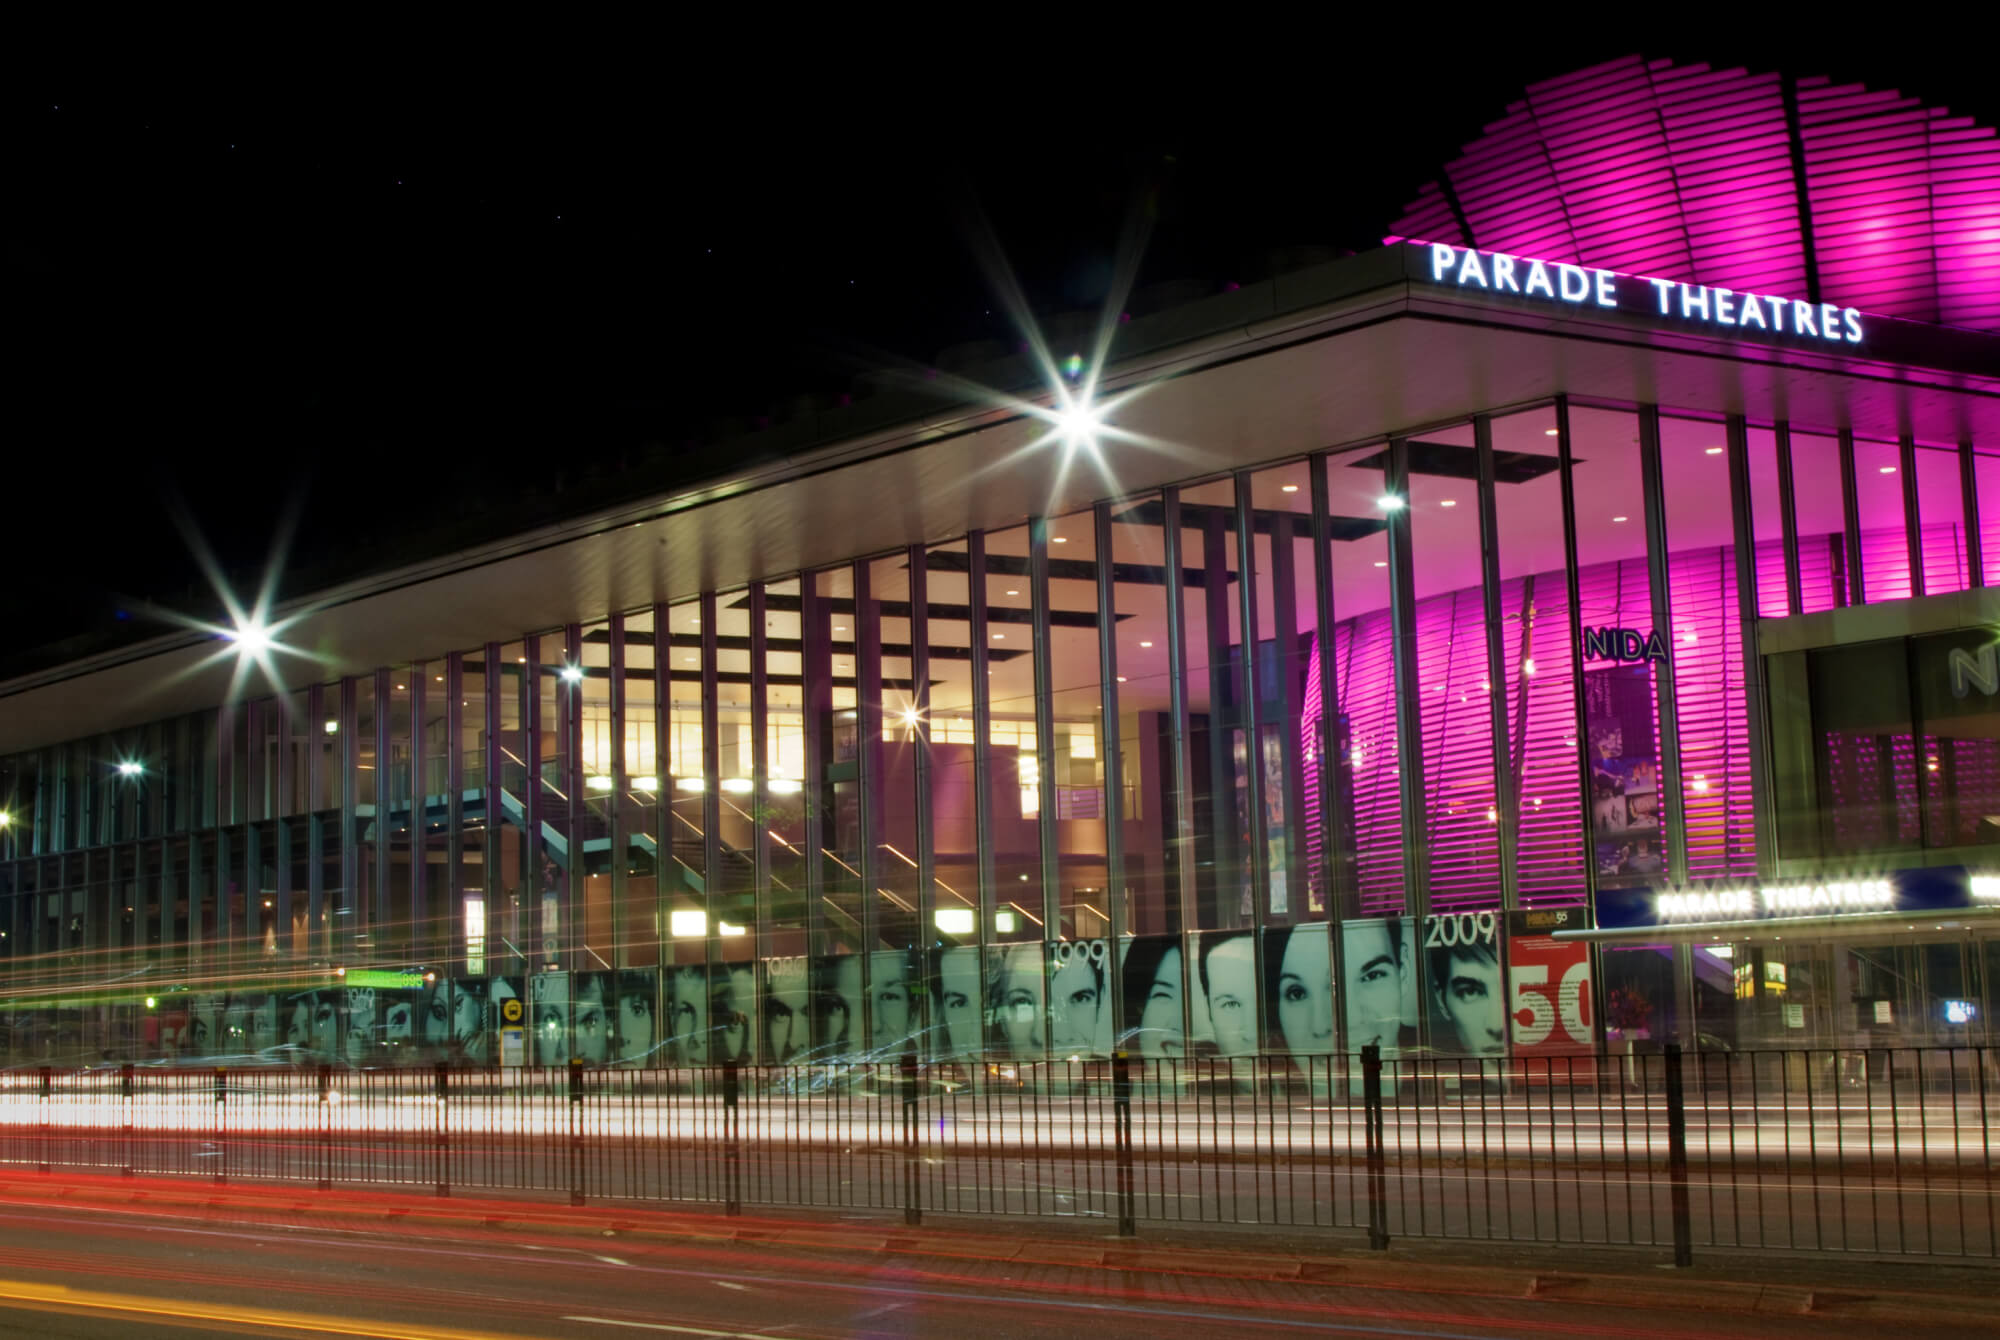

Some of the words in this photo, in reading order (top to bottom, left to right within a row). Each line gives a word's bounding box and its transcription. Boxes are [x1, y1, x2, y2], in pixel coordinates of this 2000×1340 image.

[1431, 243, 1619, 308] PARADE
[1650, 277, 1865, 345] THEATRES
[1583, 625, 1669, 665] NIDA
[1657, 888, 1753, 916] PARADE
[1760, 879, 1894, 910] THEATRES
[1424, 911, 1496, 948] 2009
[1049, 939, 1105, 971] 1999
[1510, 962, 1591, 1046] 50
